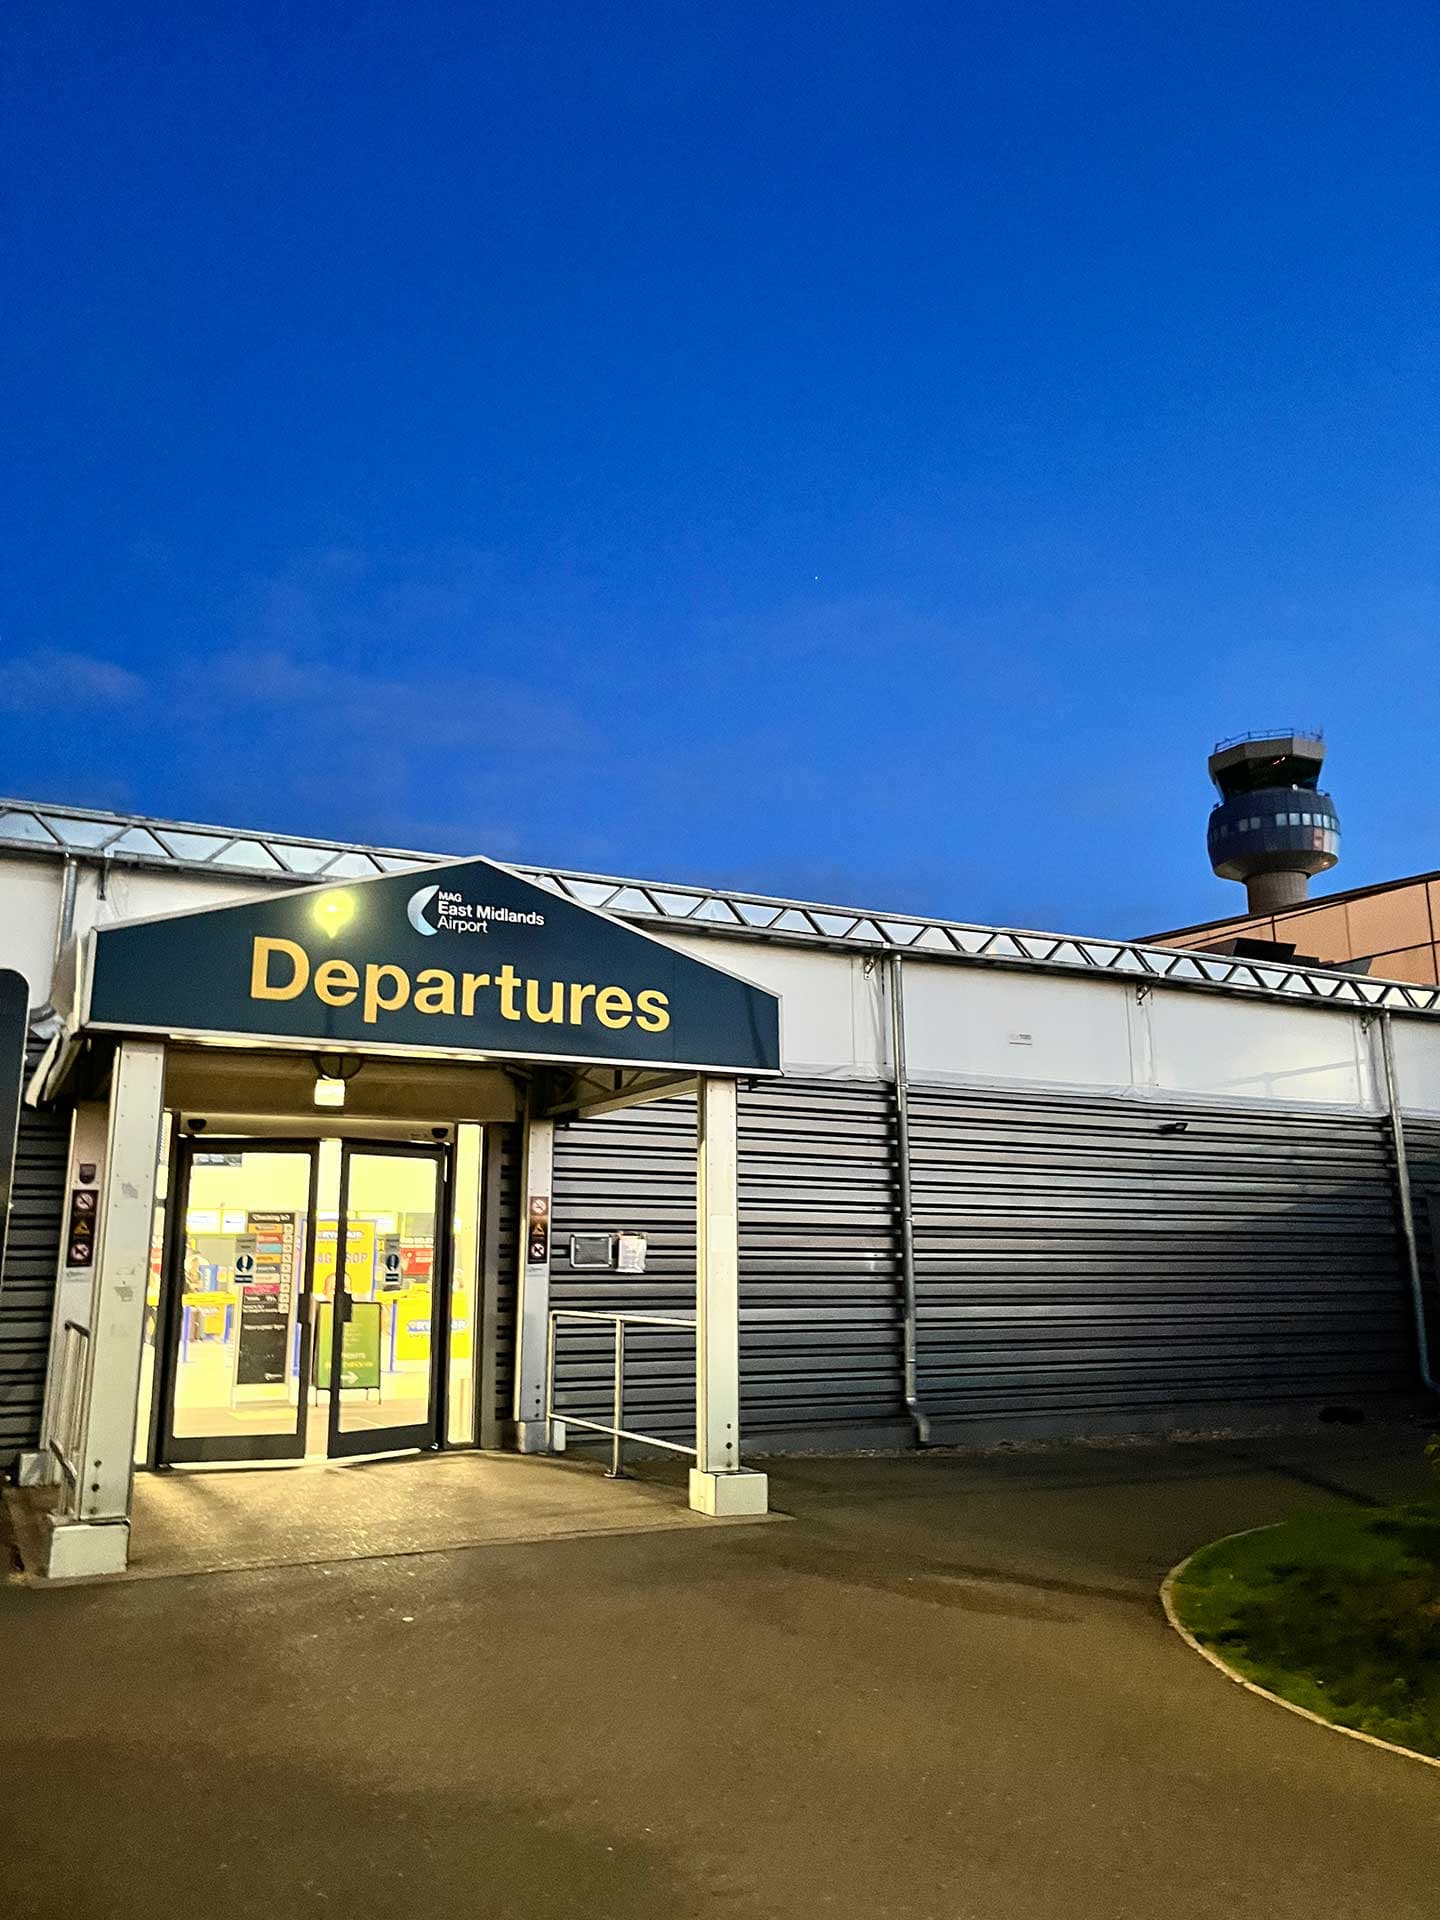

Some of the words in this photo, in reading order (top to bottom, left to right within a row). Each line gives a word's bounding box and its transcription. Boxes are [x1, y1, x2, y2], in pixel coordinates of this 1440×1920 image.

[438, 891, 462, 903] MAG
[436, 914, 488, 934] Airport
[437, 900, 473, 918] East
[476, 904, 545, 926] Midlands
[250, 936, 671, 1033] Departures
